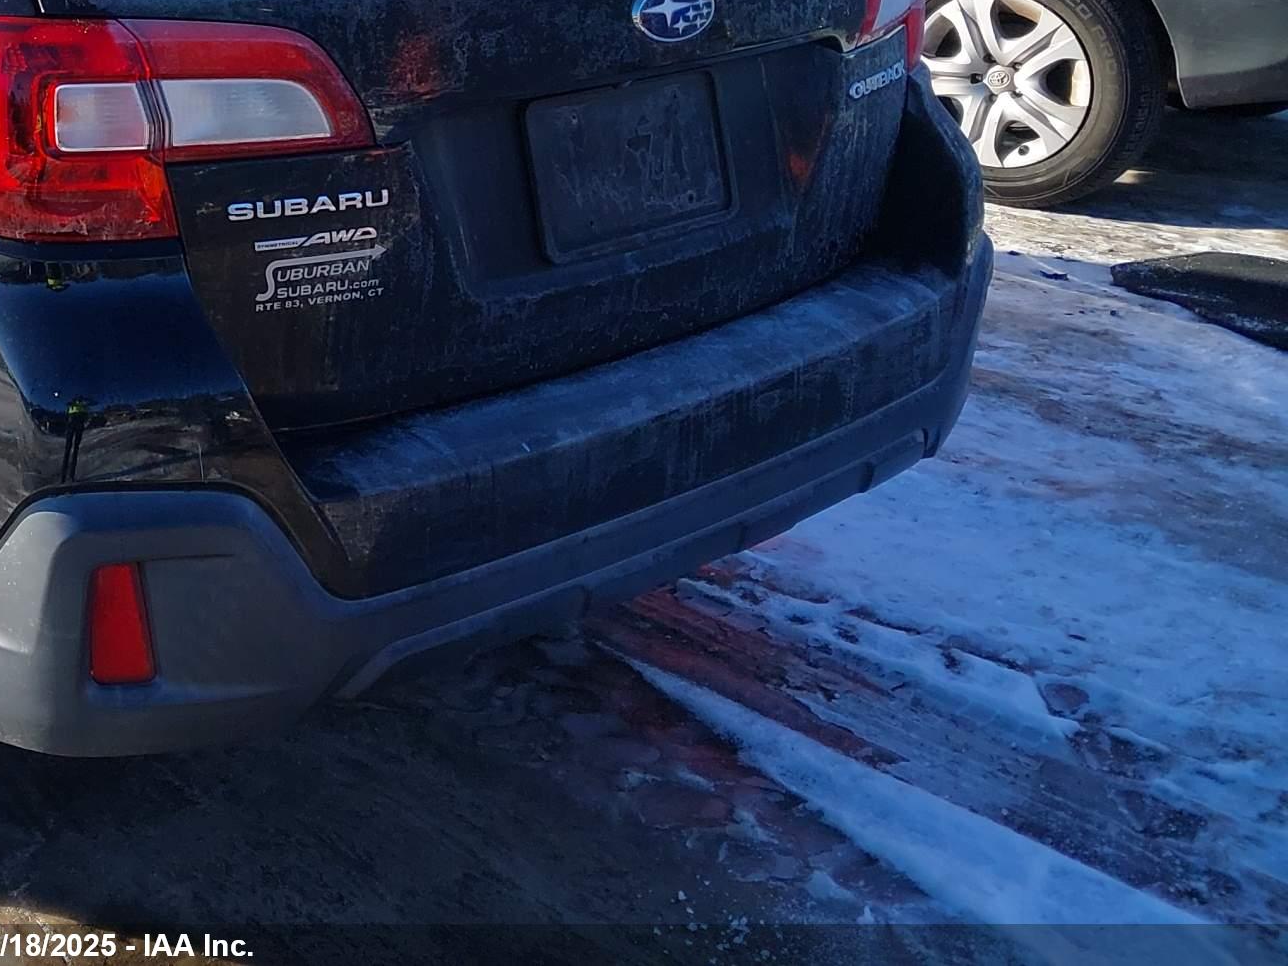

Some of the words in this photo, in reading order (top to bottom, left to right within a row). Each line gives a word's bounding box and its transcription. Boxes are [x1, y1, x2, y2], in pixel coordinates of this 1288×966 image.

[227, 189, 390, 221] SUBARU
[302, 227, 377, 247] AWD
[255, 302, 282, 312] RTE
[308, 291, 364, 305] VERNON,
[368, 287, 385, 297] CT
[277, 279, 379, 298] SUBARU.com
